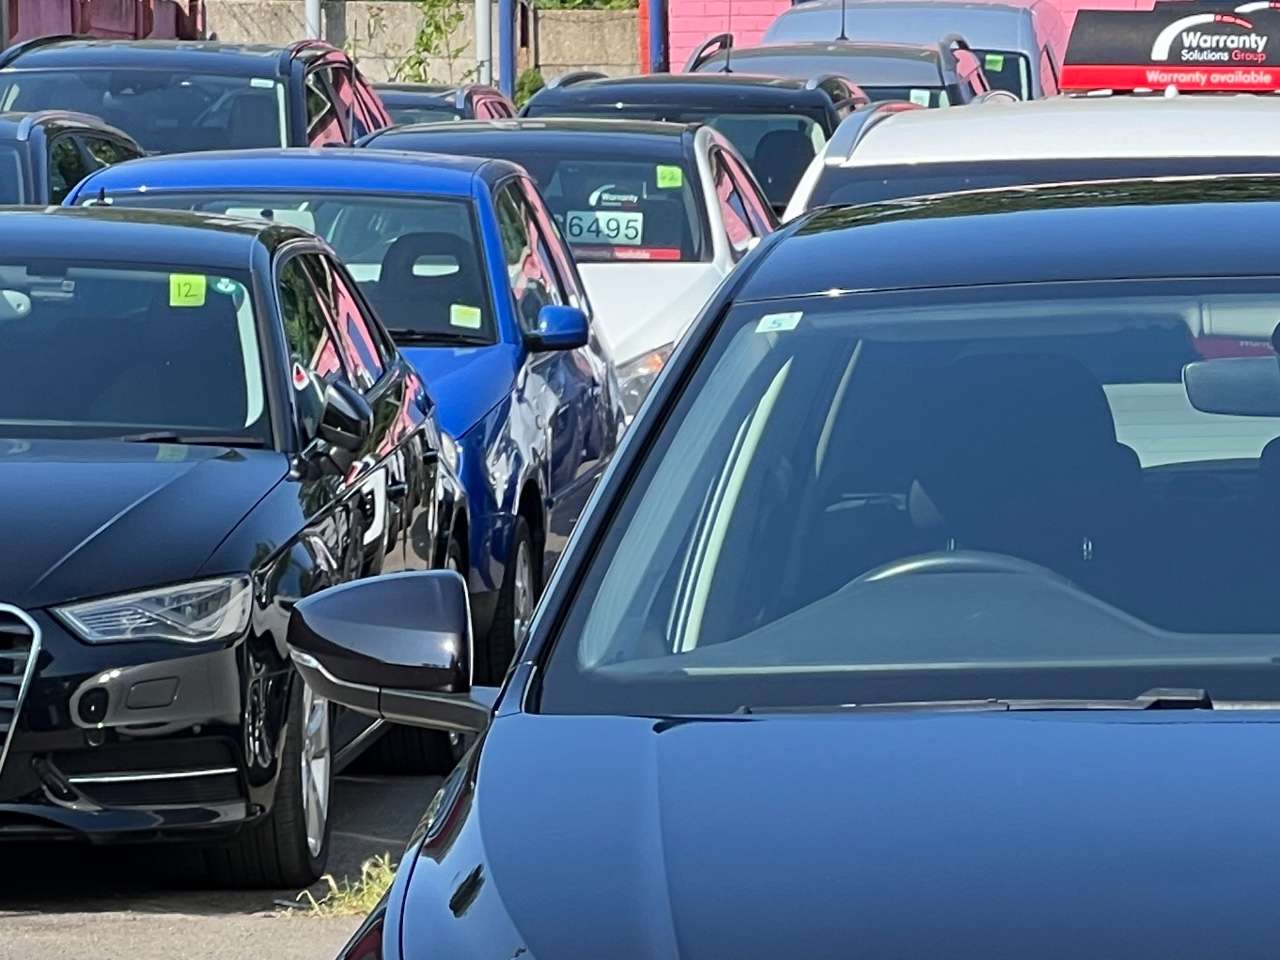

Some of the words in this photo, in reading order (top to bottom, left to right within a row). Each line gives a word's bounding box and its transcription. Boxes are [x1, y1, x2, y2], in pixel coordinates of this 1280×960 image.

[1181, 31, 1267, 52] Warranty
[1181, 50, 1229, 61] Solutions
[1231, 50, 1266, 63] Group
[1146, 70, 1207, 86] Warranty
[1210, 71, 1272, 83] available
[177, 282, 198, 298] 12
